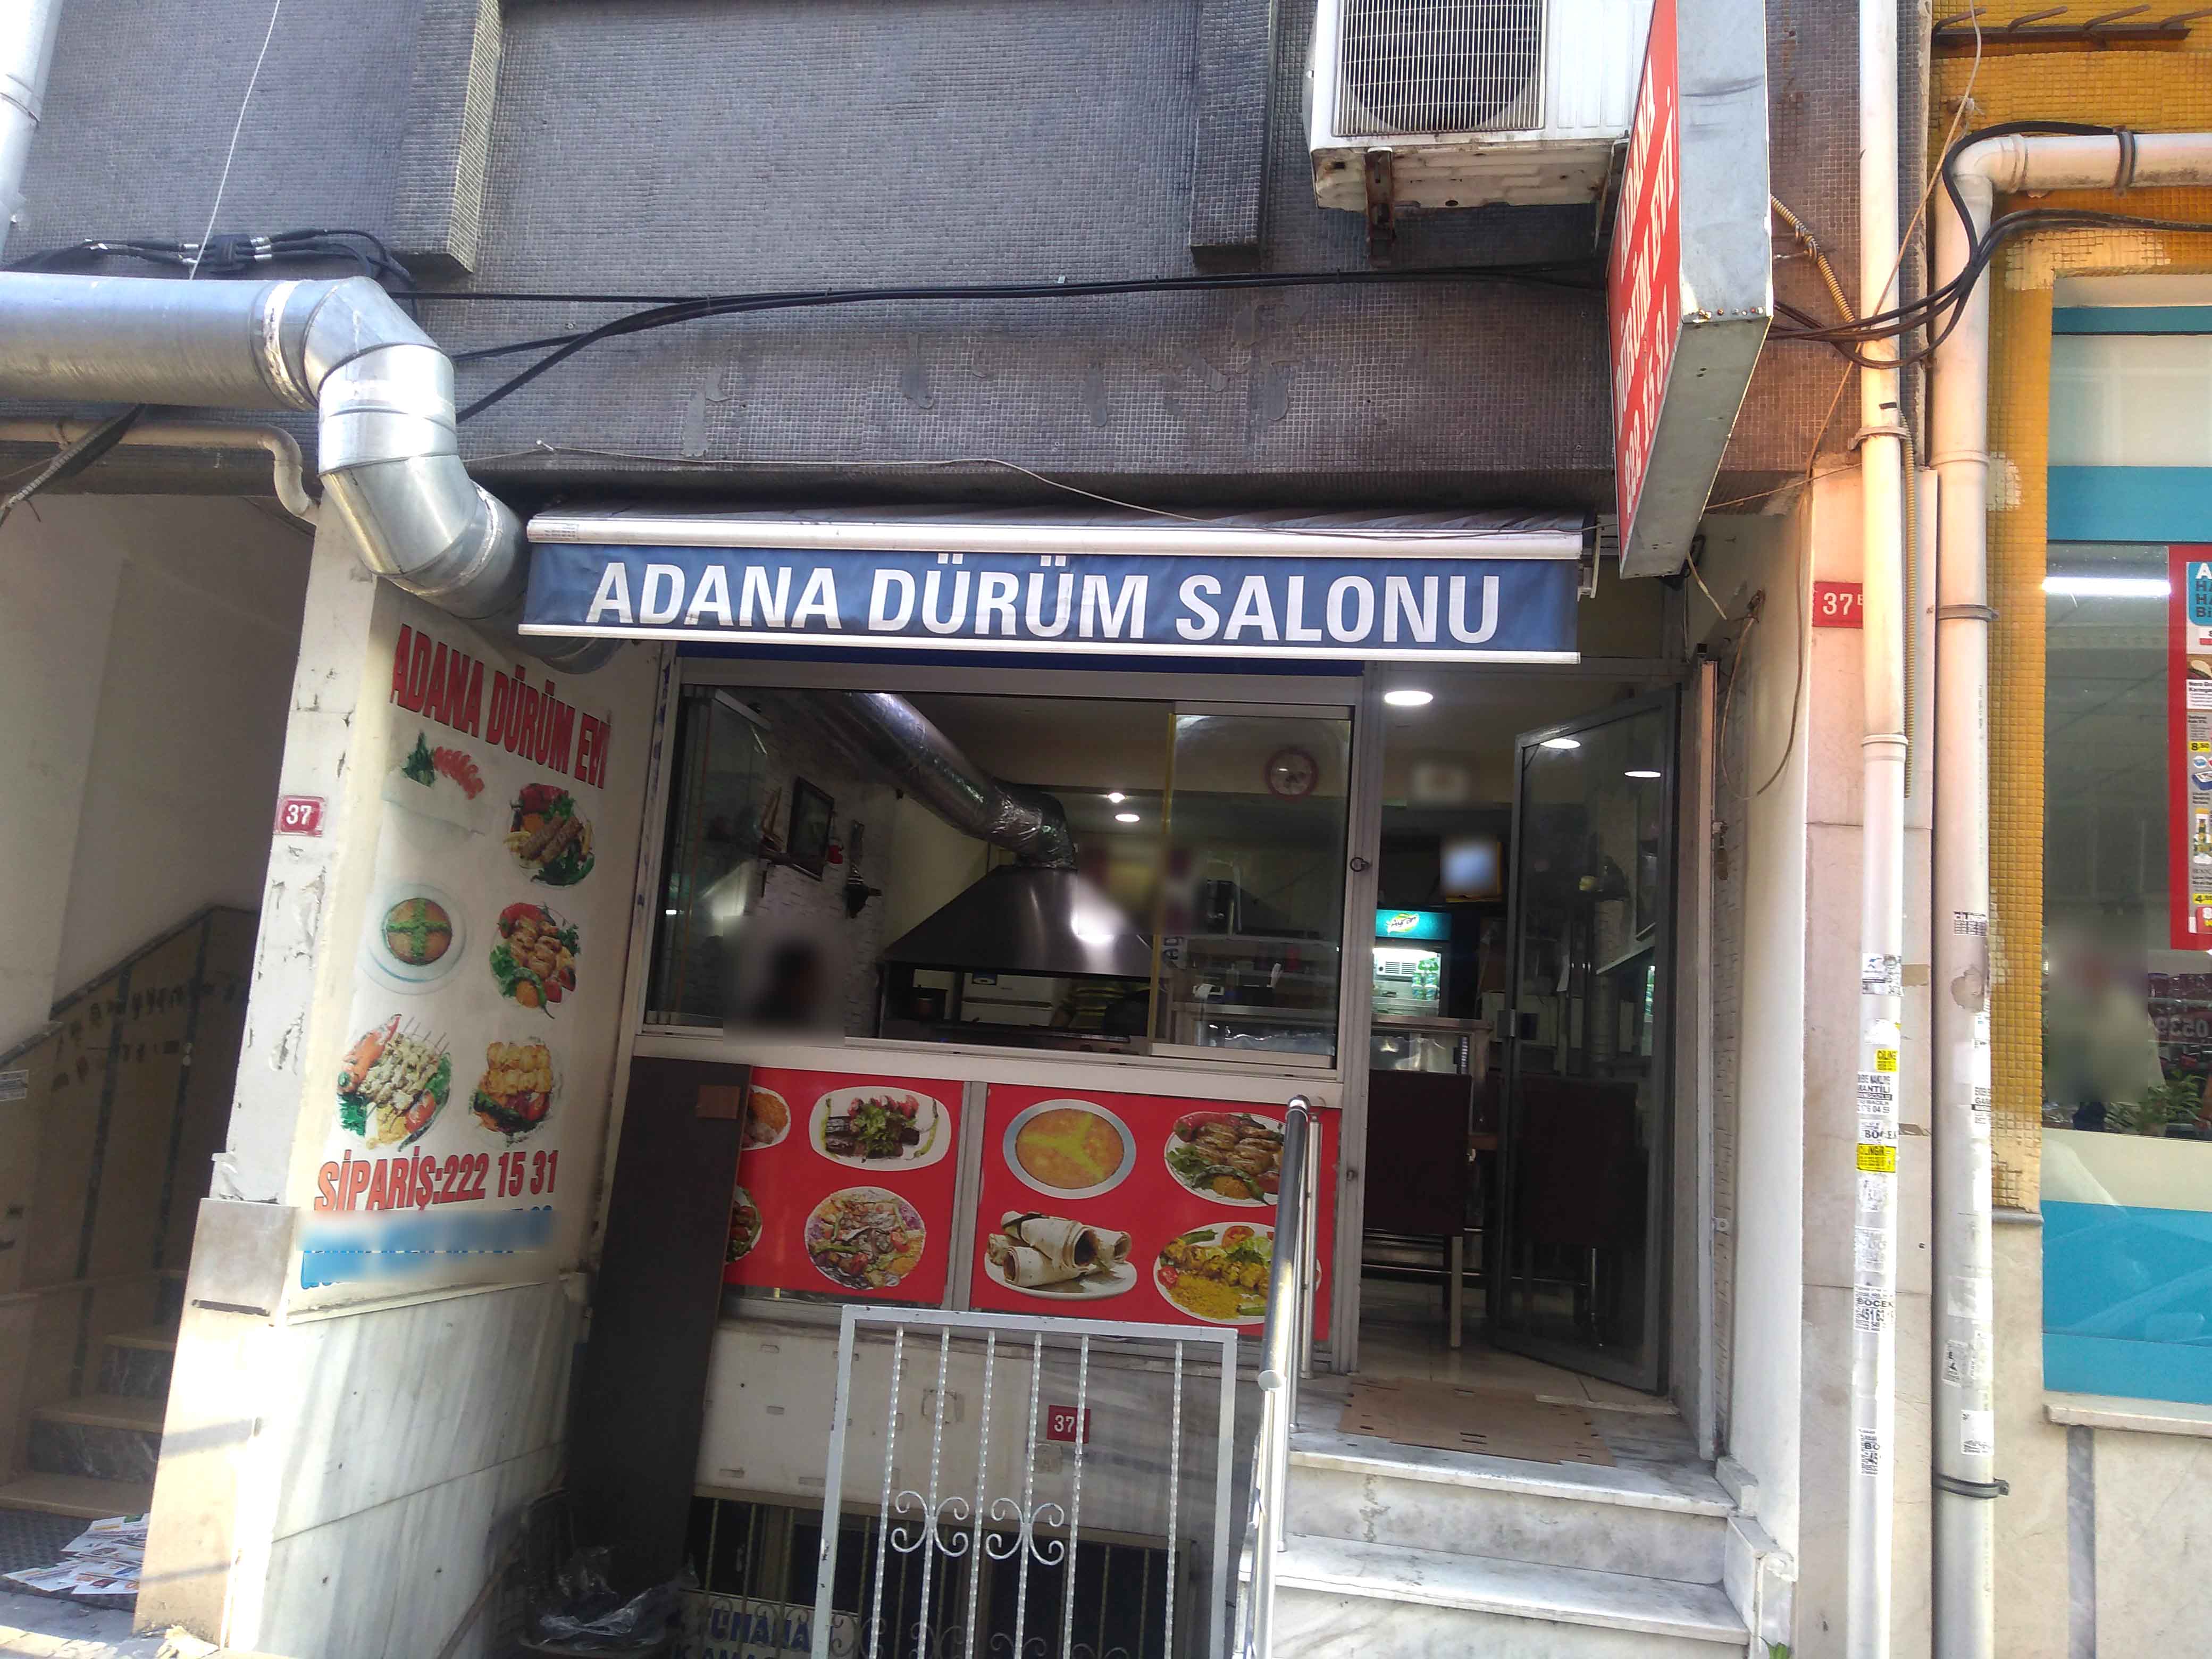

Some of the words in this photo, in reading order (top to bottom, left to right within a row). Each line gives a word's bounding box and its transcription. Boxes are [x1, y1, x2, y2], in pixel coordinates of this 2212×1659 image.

[1621, 55, 1655, 283] ADANA
[1616, 223, 1651, 441] DÜRÜM
[1650, 85, 1674, 282] EVİ
[1625, 409, 1641, 519] 222
[1643, 346, 1656, 451] 15
[1656, 283, 1670, 395] 31
[585, 562, 843, 630] ADANA
[867, 553, 1149, 639] DÜRÜM
[1176, 574, 1499, 644] SALONU
[390, 623, 484, 738] ADANA
[486, 664, 576, 774] DÜRÜM
[574, 709, 612, 789] EVİ
[286, 805, 312, 825] 37
[498, 1152, 527, 1198] 15
[530, 1150, 559, 1195] 31
[1053, 1414, 1075, 1433] 37
